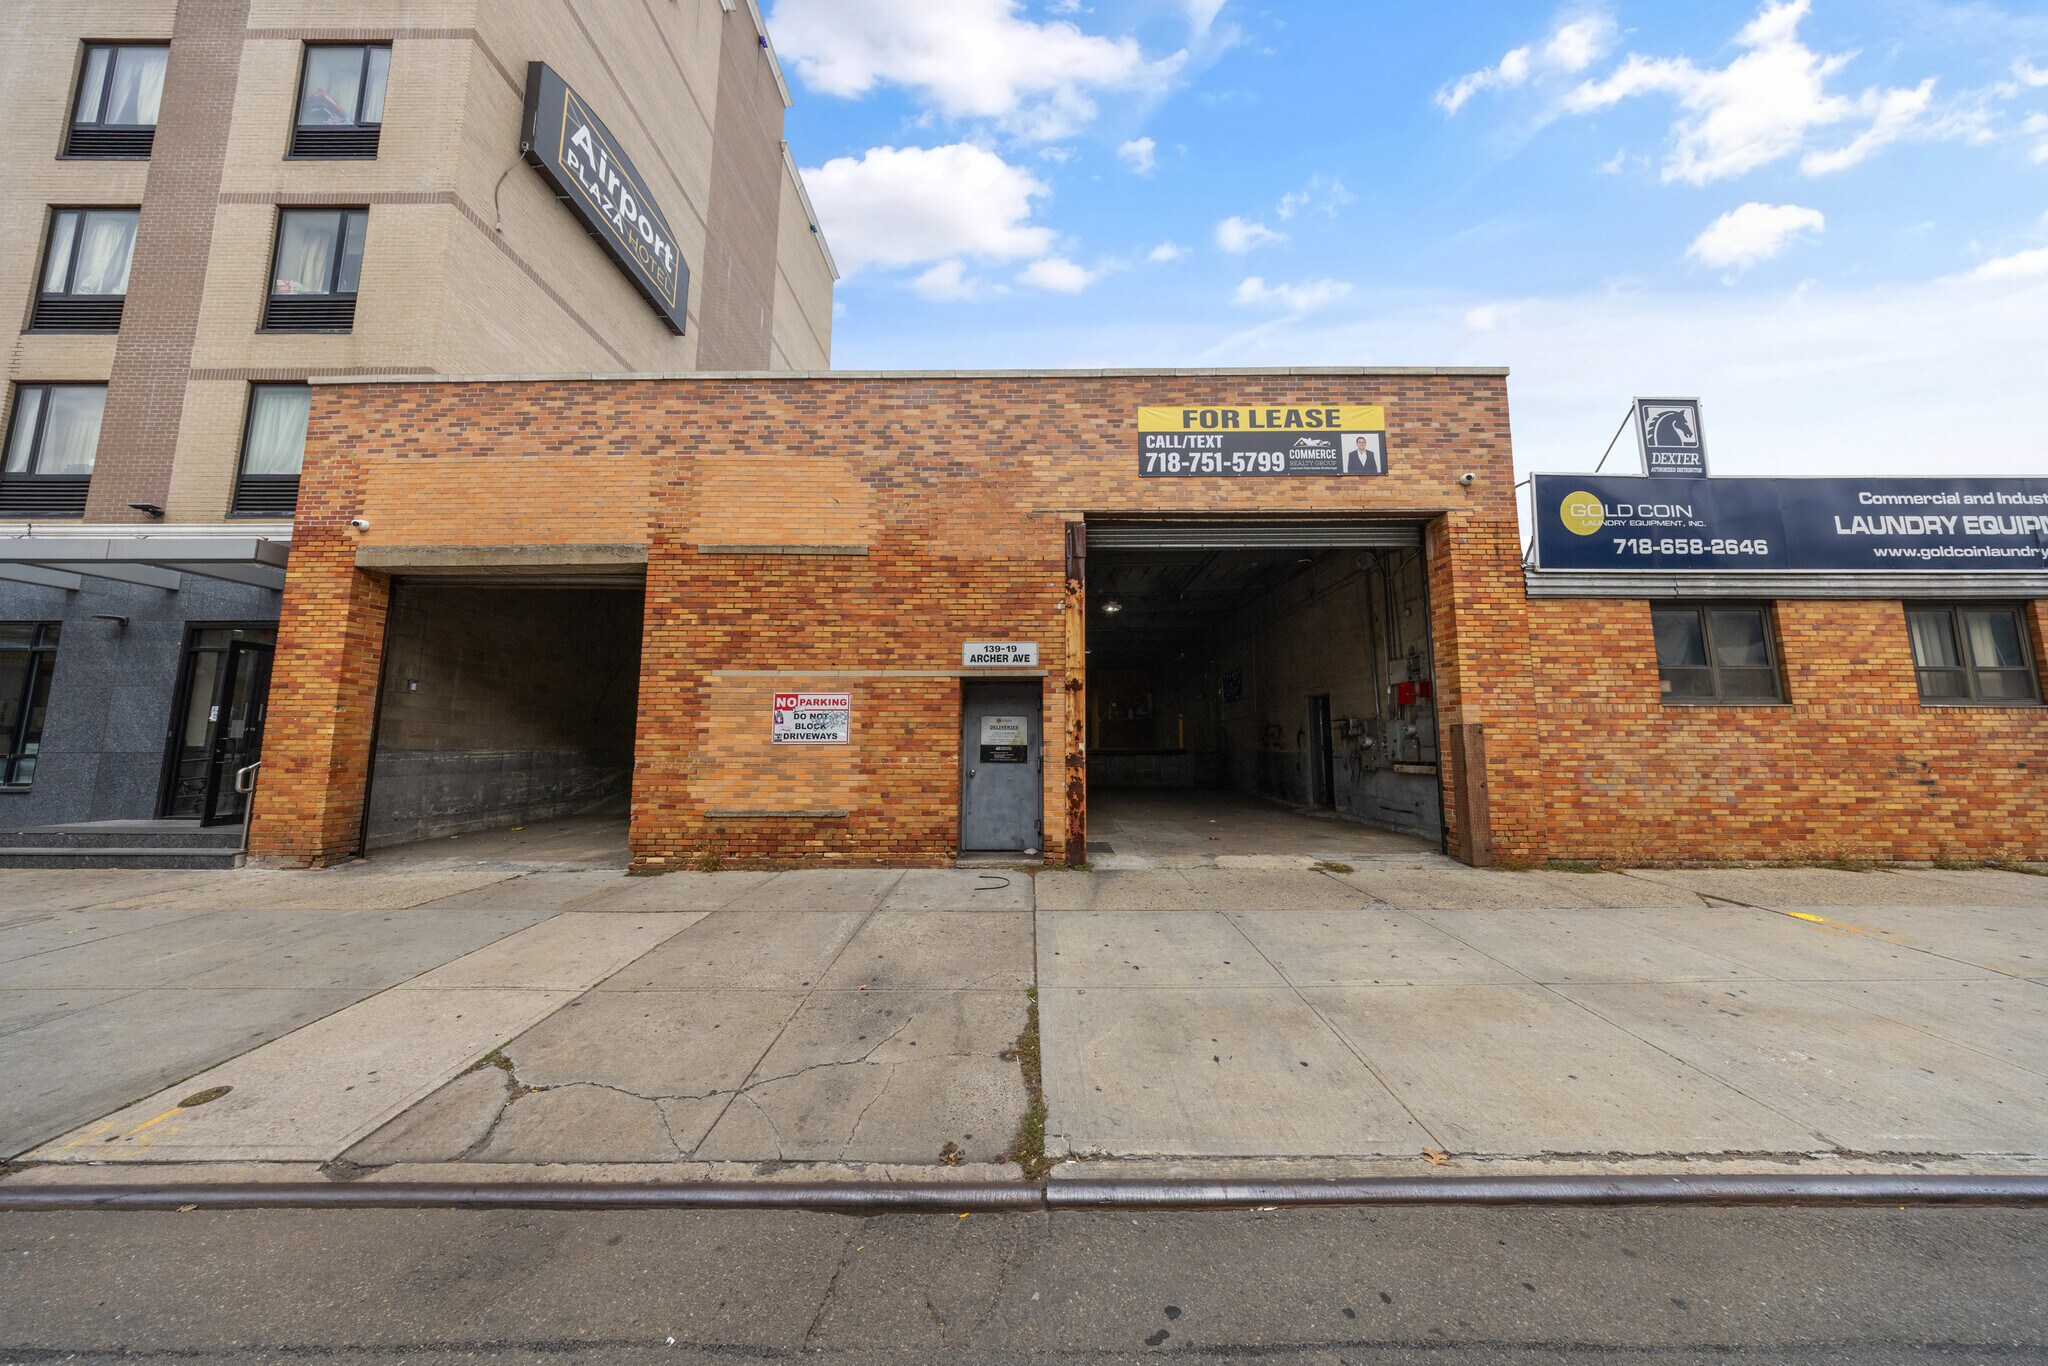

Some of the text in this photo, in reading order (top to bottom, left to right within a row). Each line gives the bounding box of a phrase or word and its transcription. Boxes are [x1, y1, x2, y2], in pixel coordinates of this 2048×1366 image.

[567, 148, 625, 235] PLAZA
[571, 124, 674, 274] Airport
[628, 229, 672, 295] HOTEL
[1183, 408, 1342, 429] FOR LEASE
[1145, 435, 1224, 449] CALL/TEXT
[1289, 449, 1337, 459] COMMERCE
[1651, 452, 1701, 465] DEXTER
[1145, 452, 1286, 473] 718-751-5799
[1858, 491, 1961, 505] Commercial
[1963, 491, 1995, 505] and
[1570, 503, 1693, 518] GOLD COIN
[1582, 519, 1627, 527] LAUNDRY
[1629, 520, 1686, 528] EQUIPMENT,
[1834, 515, 1958, 535] LAUNDRY
[1613, 538, 1769, 555] 718-658-2646
[983, 645, 1018, 653] 139-19
[970, 654, 1031, 663] ARCHER AVE
[775, 697, 847, 708] NO PARKING
[783, 732, 838, 740] DRIVEWAYS
